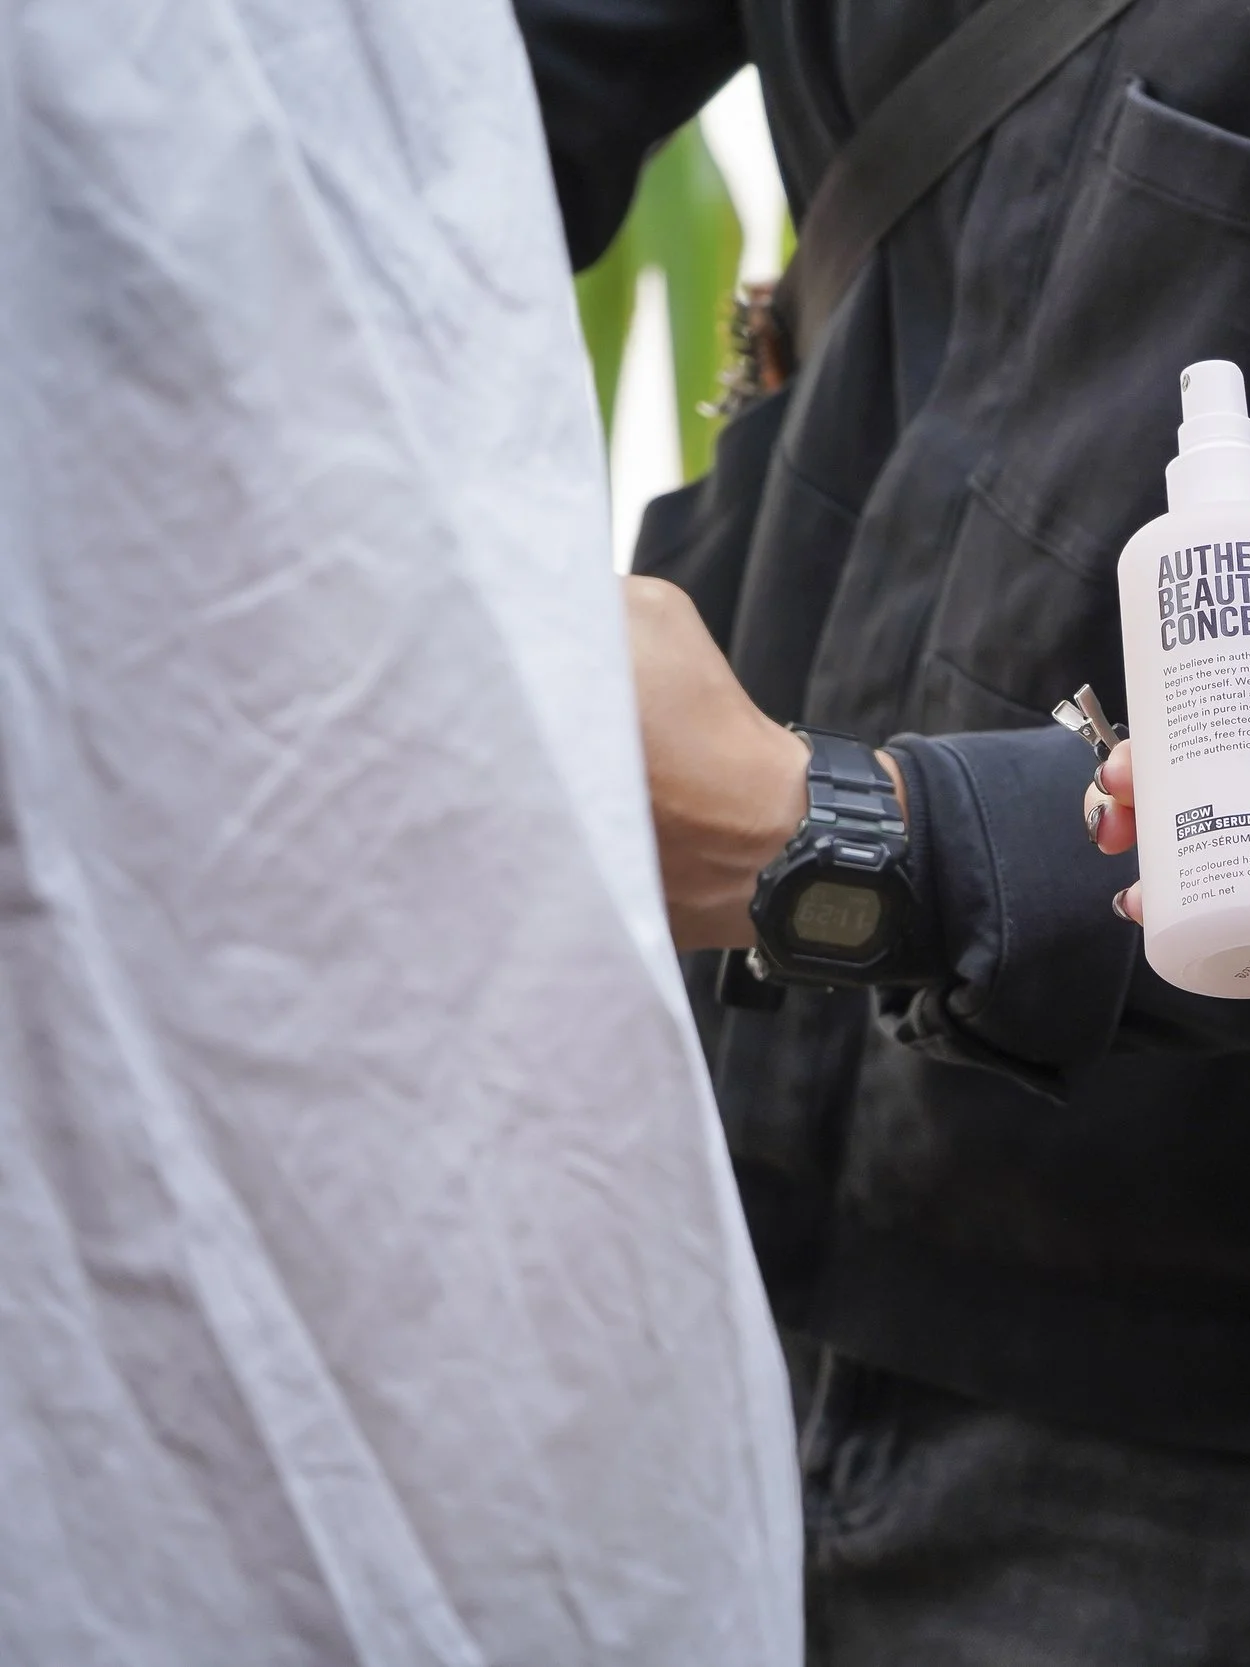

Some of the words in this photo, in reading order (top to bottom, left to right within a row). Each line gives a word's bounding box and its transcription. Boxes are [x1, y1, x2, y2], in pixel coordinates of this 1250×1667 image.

[1163, 666, 1177, 676] We
[1180, 657, 1213, 671] believe
[1217, 654, 1226, 662] in
[1164, 675, 1193, 688] begins
[1196, 670, 1212, 678] the
[1165, 693, 1174, 702] to
[1176, 688, 1187, 698] be
[1189, 680, 1232, 696] yourself.
[1166, 698, 1196, 714] beauty
[1200, 696, 1207, 704] is
[1210, 690, 1245, 702] natural
[1167, 712, 1199, 727] believe
[1202, 708, 1210, 716] in
[1213, 705, 1236, 716] pure
[1168, 722, 1207, 740] carefully
[1169, 735, 1212, 752] formulas,
[1215, 730, 1235, 740] free
[1171, 755, 1184, 765] are
[1187, 750, 1201, 759] the
[1203, 741, 1250, 754] authentic
[1177, 807, 1211, 824] GLOW
[1178, 821, 1213, 839] SPRAY
[1177, 834, 1250, 857] SPRAY-SÉRUM
[1179, 868, 1193, 878] For
[1196, 857, 1239, 872] coloured
[1180, 879, 1201, 890] Pour
[1203, 871, 1244, 884] cheveux
[1181, 893, 1199, 906] 200
[1201, 889, 1216, 899] mL
[1219, 886, 1235, 895] net
